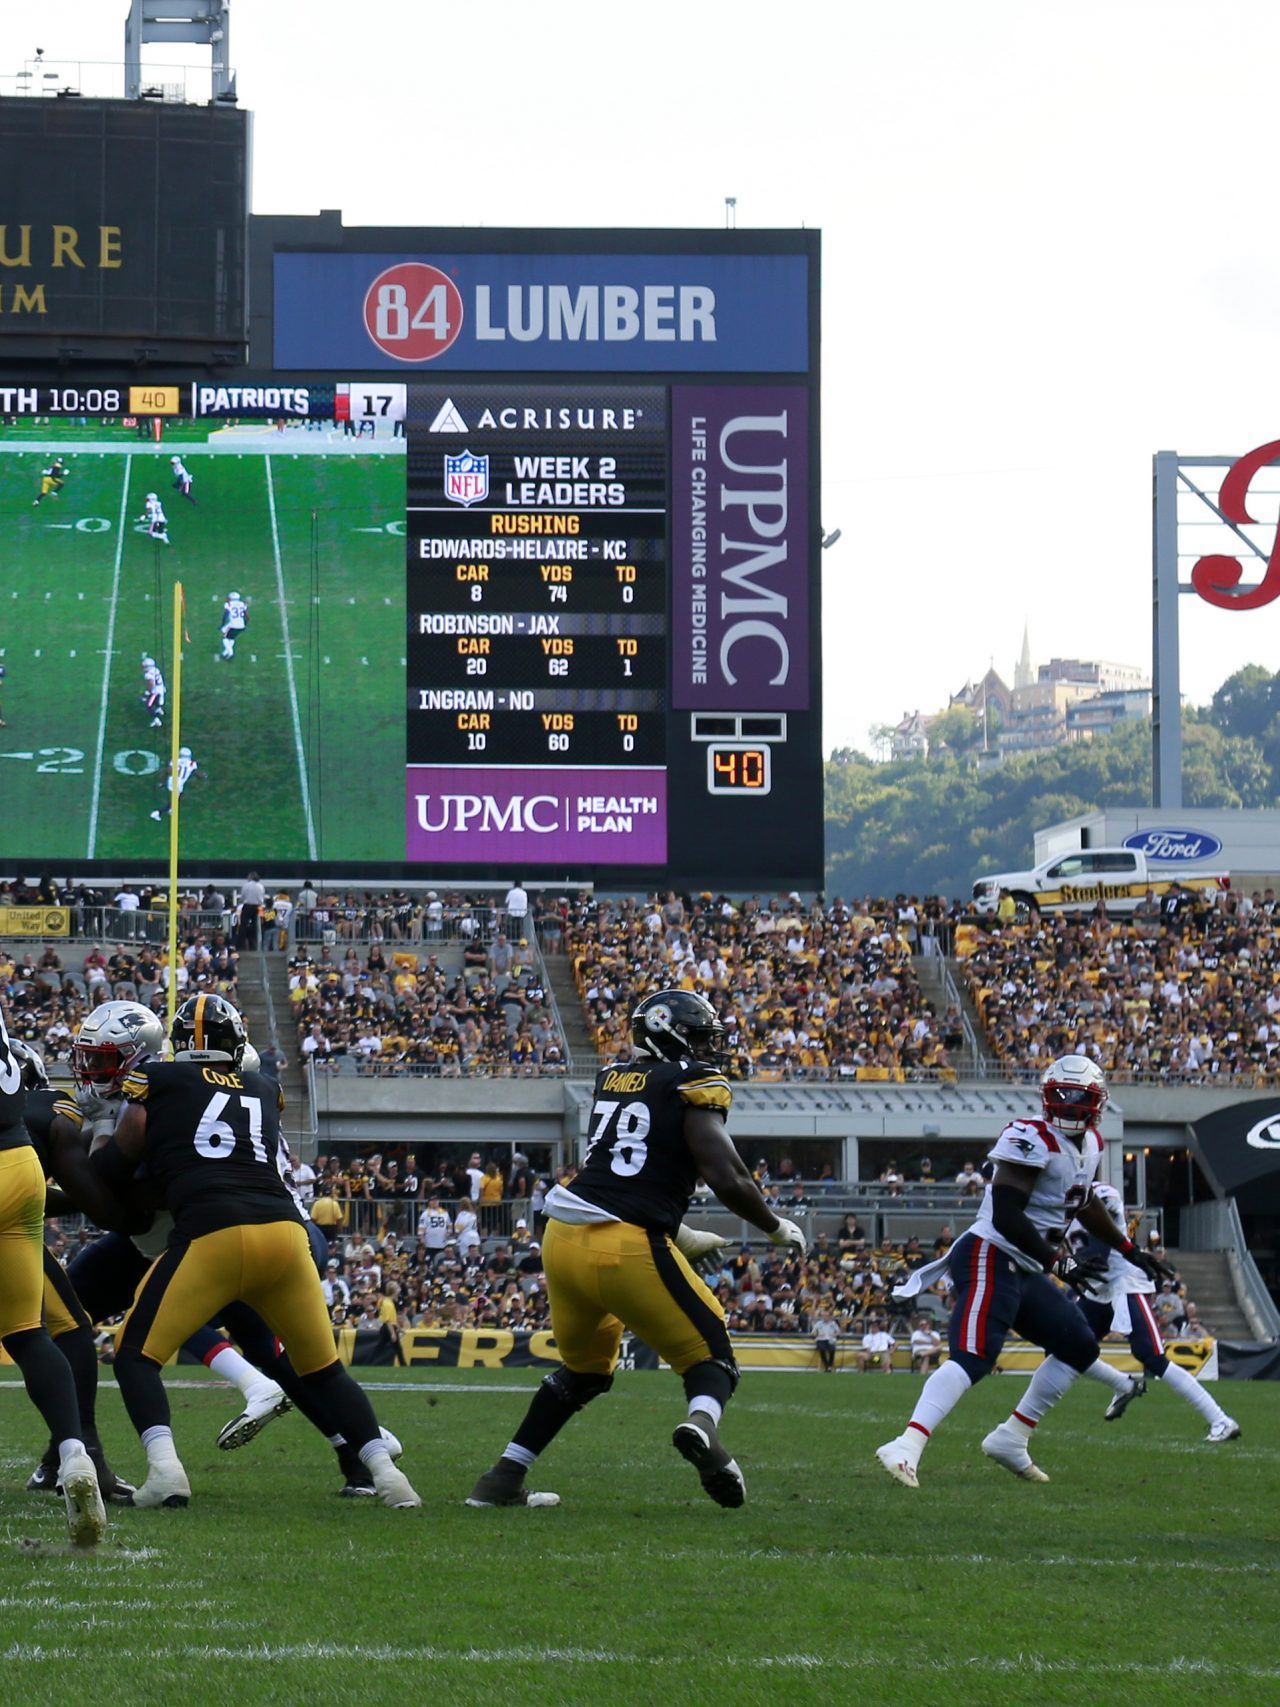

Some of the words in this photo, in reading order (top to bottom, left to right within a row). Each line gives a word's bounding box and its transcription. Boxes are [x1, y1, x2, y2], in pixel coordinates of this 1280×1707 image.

[376, 284, 450, 340] 84
[475, 285, 717, 342] LUMBER
[49, 388, 120, 413] 10:08
[141, 392, 166, 409] 40
[200, 387, 310, 414] PATRIOTS
[363, 395, 394, 417] 17
[691, 417, 707, 461] LIFE
[514, 457, 590, 479] WEEK
[599, 457, 616, 479] 2
[450, 474, 483, 496] NFL
[506, 483, 625, 505] LEADERS
[491, 514, 580, 534] RUSHING
[691, 469, 707, 579] CHANGING
[420, 538, 588, 560] EDWARDS-HELAIRE
[604, 540, 627, 560] KC
[719, 410, 790, 686] UPMC
[457, 565, 489, 582] CAR
[540, 565, 572, 582] YDS
[617, 565, 636, 582] TD
[471, 586, 482, 602] 8
[549, 586, 567, 602] 74
[623, 586, 633, 603] 0
[420, 614, 514, 635] ROBINSON
[528, 615, 559, 635] JAX
[692, 585, 708, 685] MEDICINE
[458, 639, 489, 656] CAR
[542, 639, 573, 656] YDS
[618, 639, 637, 656] TD
[467, 659, 487, 675] 20
[549, 659, 569, 676] 62
[624, 659, 633, 676] 1
[420, 690, 494, 710] INGRAM
[509, 691, 534, 711] NO
[458, 714, 489, 731] CAR
[542, 714, 573, 731] YDS
[618, 714, 637, 731] TD
[468, 734, 486, 750] 10
[549, 734, 569, 751] 60
[623, 735, 634, 751] 0
[715, 751, 763, 786] 40
[415, 795, 559, 833] UPMC
[578, 797, 657, 814] HEALTH
[578, 816, 633, 833] PLAN
[1142, 833, 1201, 857] Ford
[1061, 881, 1132, 901] Steelers
[10, 911, 40, 920] United
[22, 921, 40, 931] Way
[202, 1067, 244, 1089] COLE
[602, 1070, 648, 1092] DANIELS
[193, 1091, 268, 1163] 61
[584, 1101, 650, 1177] 78
